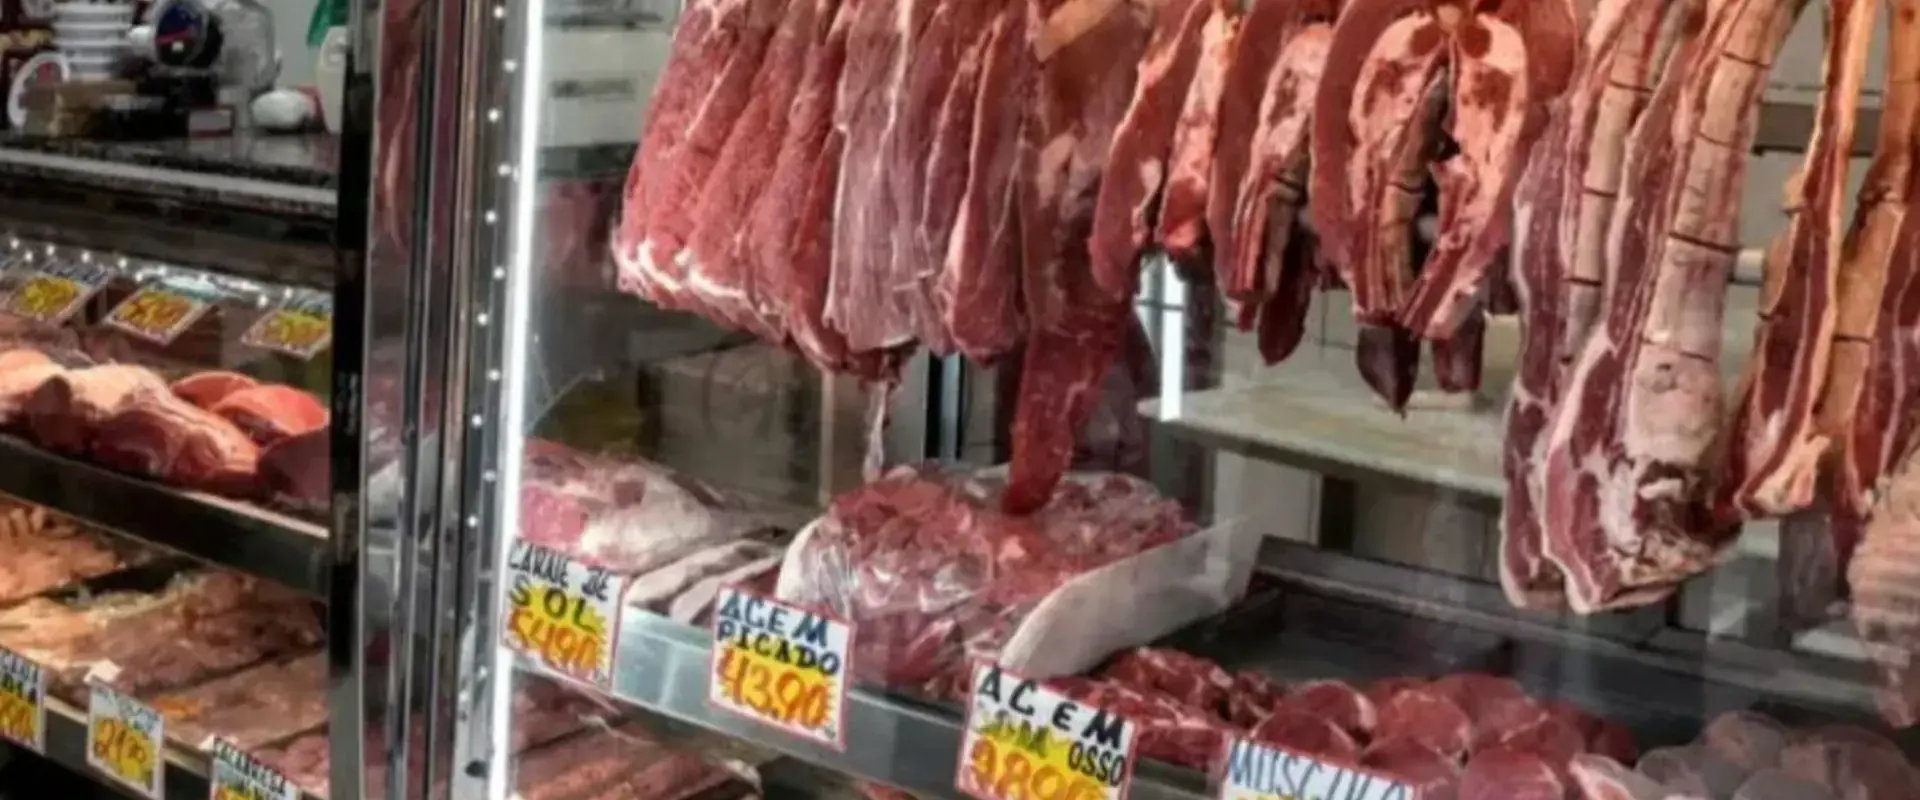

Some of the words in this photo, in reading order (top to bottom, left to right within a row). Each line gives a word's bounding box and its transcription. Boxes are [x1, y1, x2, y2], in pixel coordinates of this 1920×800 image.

[508, 573, 600, 634] SOL
[719, 590, 829, 648] ACEM
[717, 620, 840, 676] PICADO
[978, 663, 1126, 749] ACEM
[1068, 742, 1125, 787] OSSO
